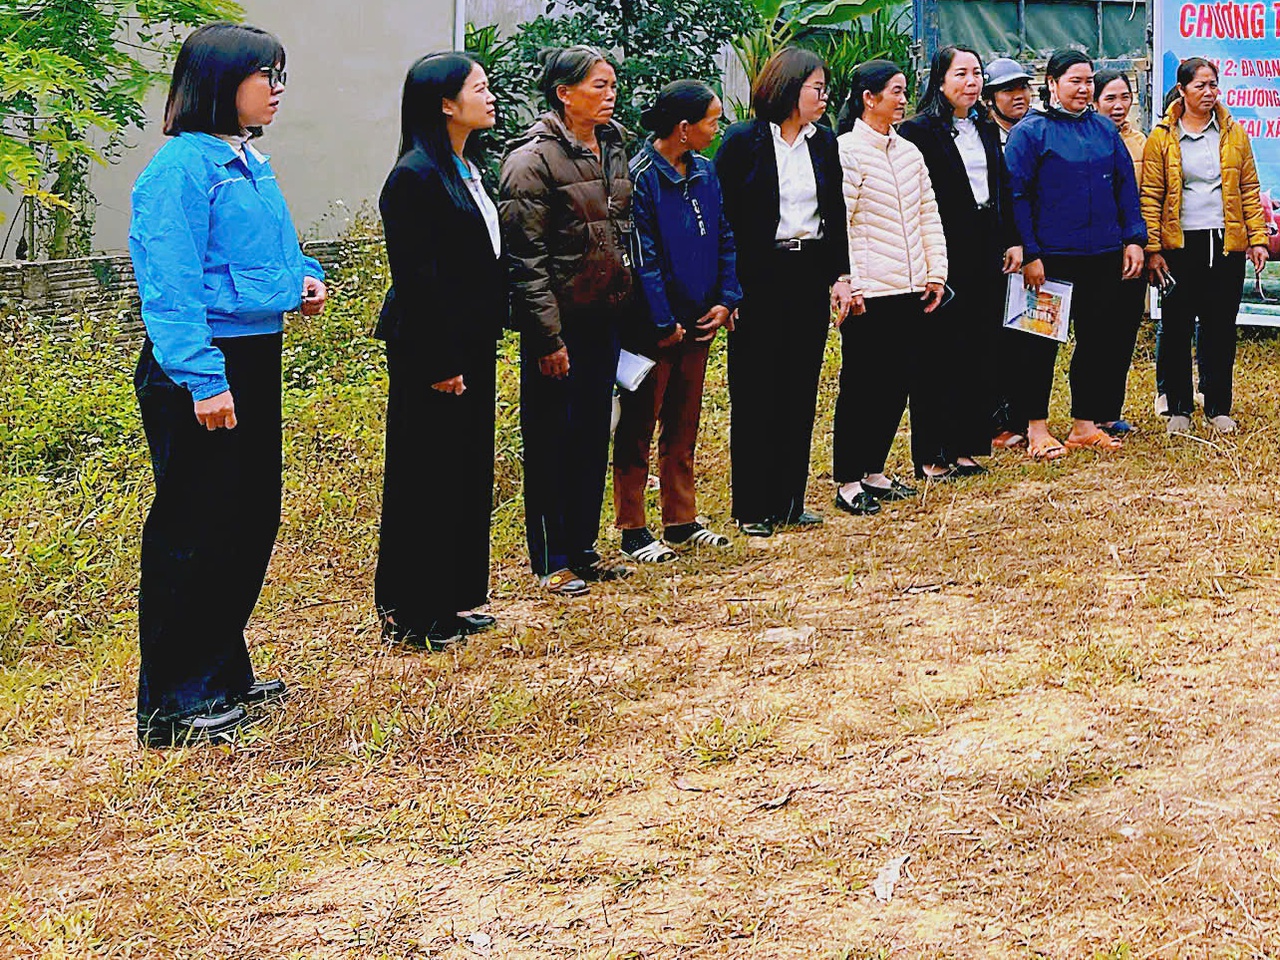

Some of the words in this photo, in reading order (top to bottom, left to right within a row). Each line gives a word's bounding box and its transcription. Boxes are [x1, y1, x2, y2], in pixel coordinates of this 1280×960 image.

[1179, 1, 1265, 39] CHƯƠNG
[1223, 59, 1238, 76] 2:
[1241, 59, 1256, 76] ĐA
[1226, 88, 1280, 107] CHƯƠNG
